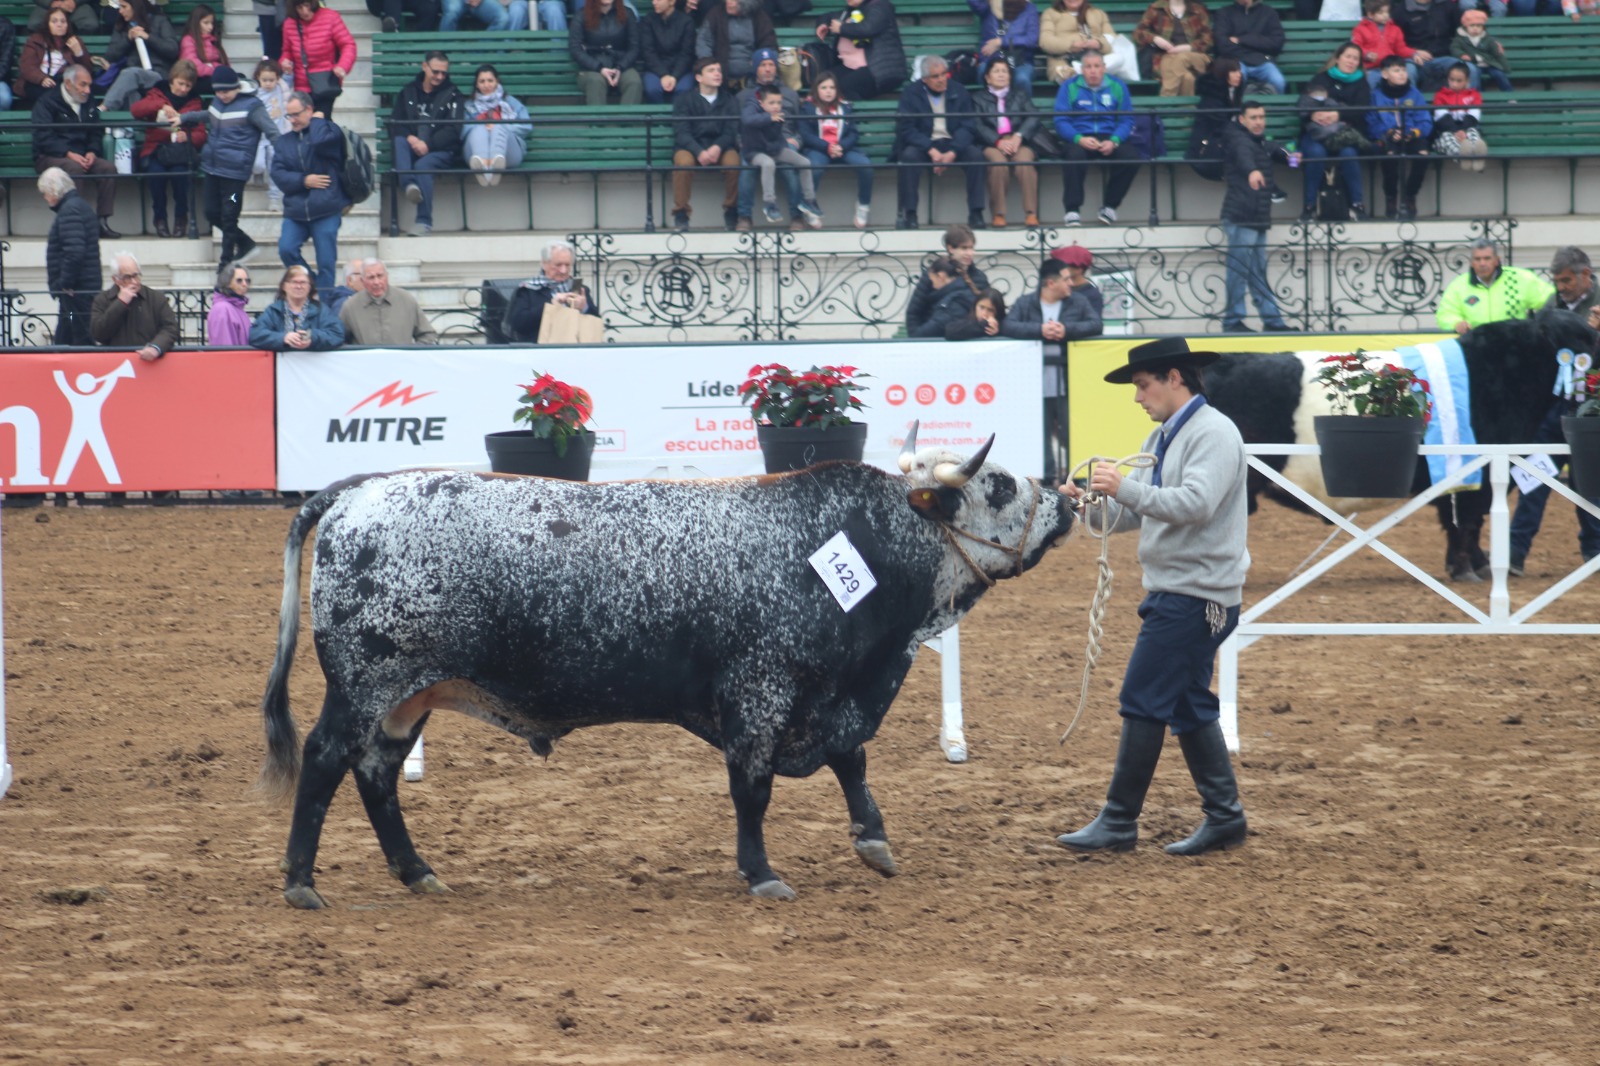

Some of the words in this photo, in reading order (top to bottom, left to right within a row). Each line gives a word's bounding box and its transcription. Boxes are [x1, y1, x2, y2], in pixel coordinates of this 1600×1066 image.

[326, 416, 447, 446] MITRE
[695, 417, 717, 432] La
[664, 436, 760, 453] escuchad
[828, 551, 860, 594] 1429
